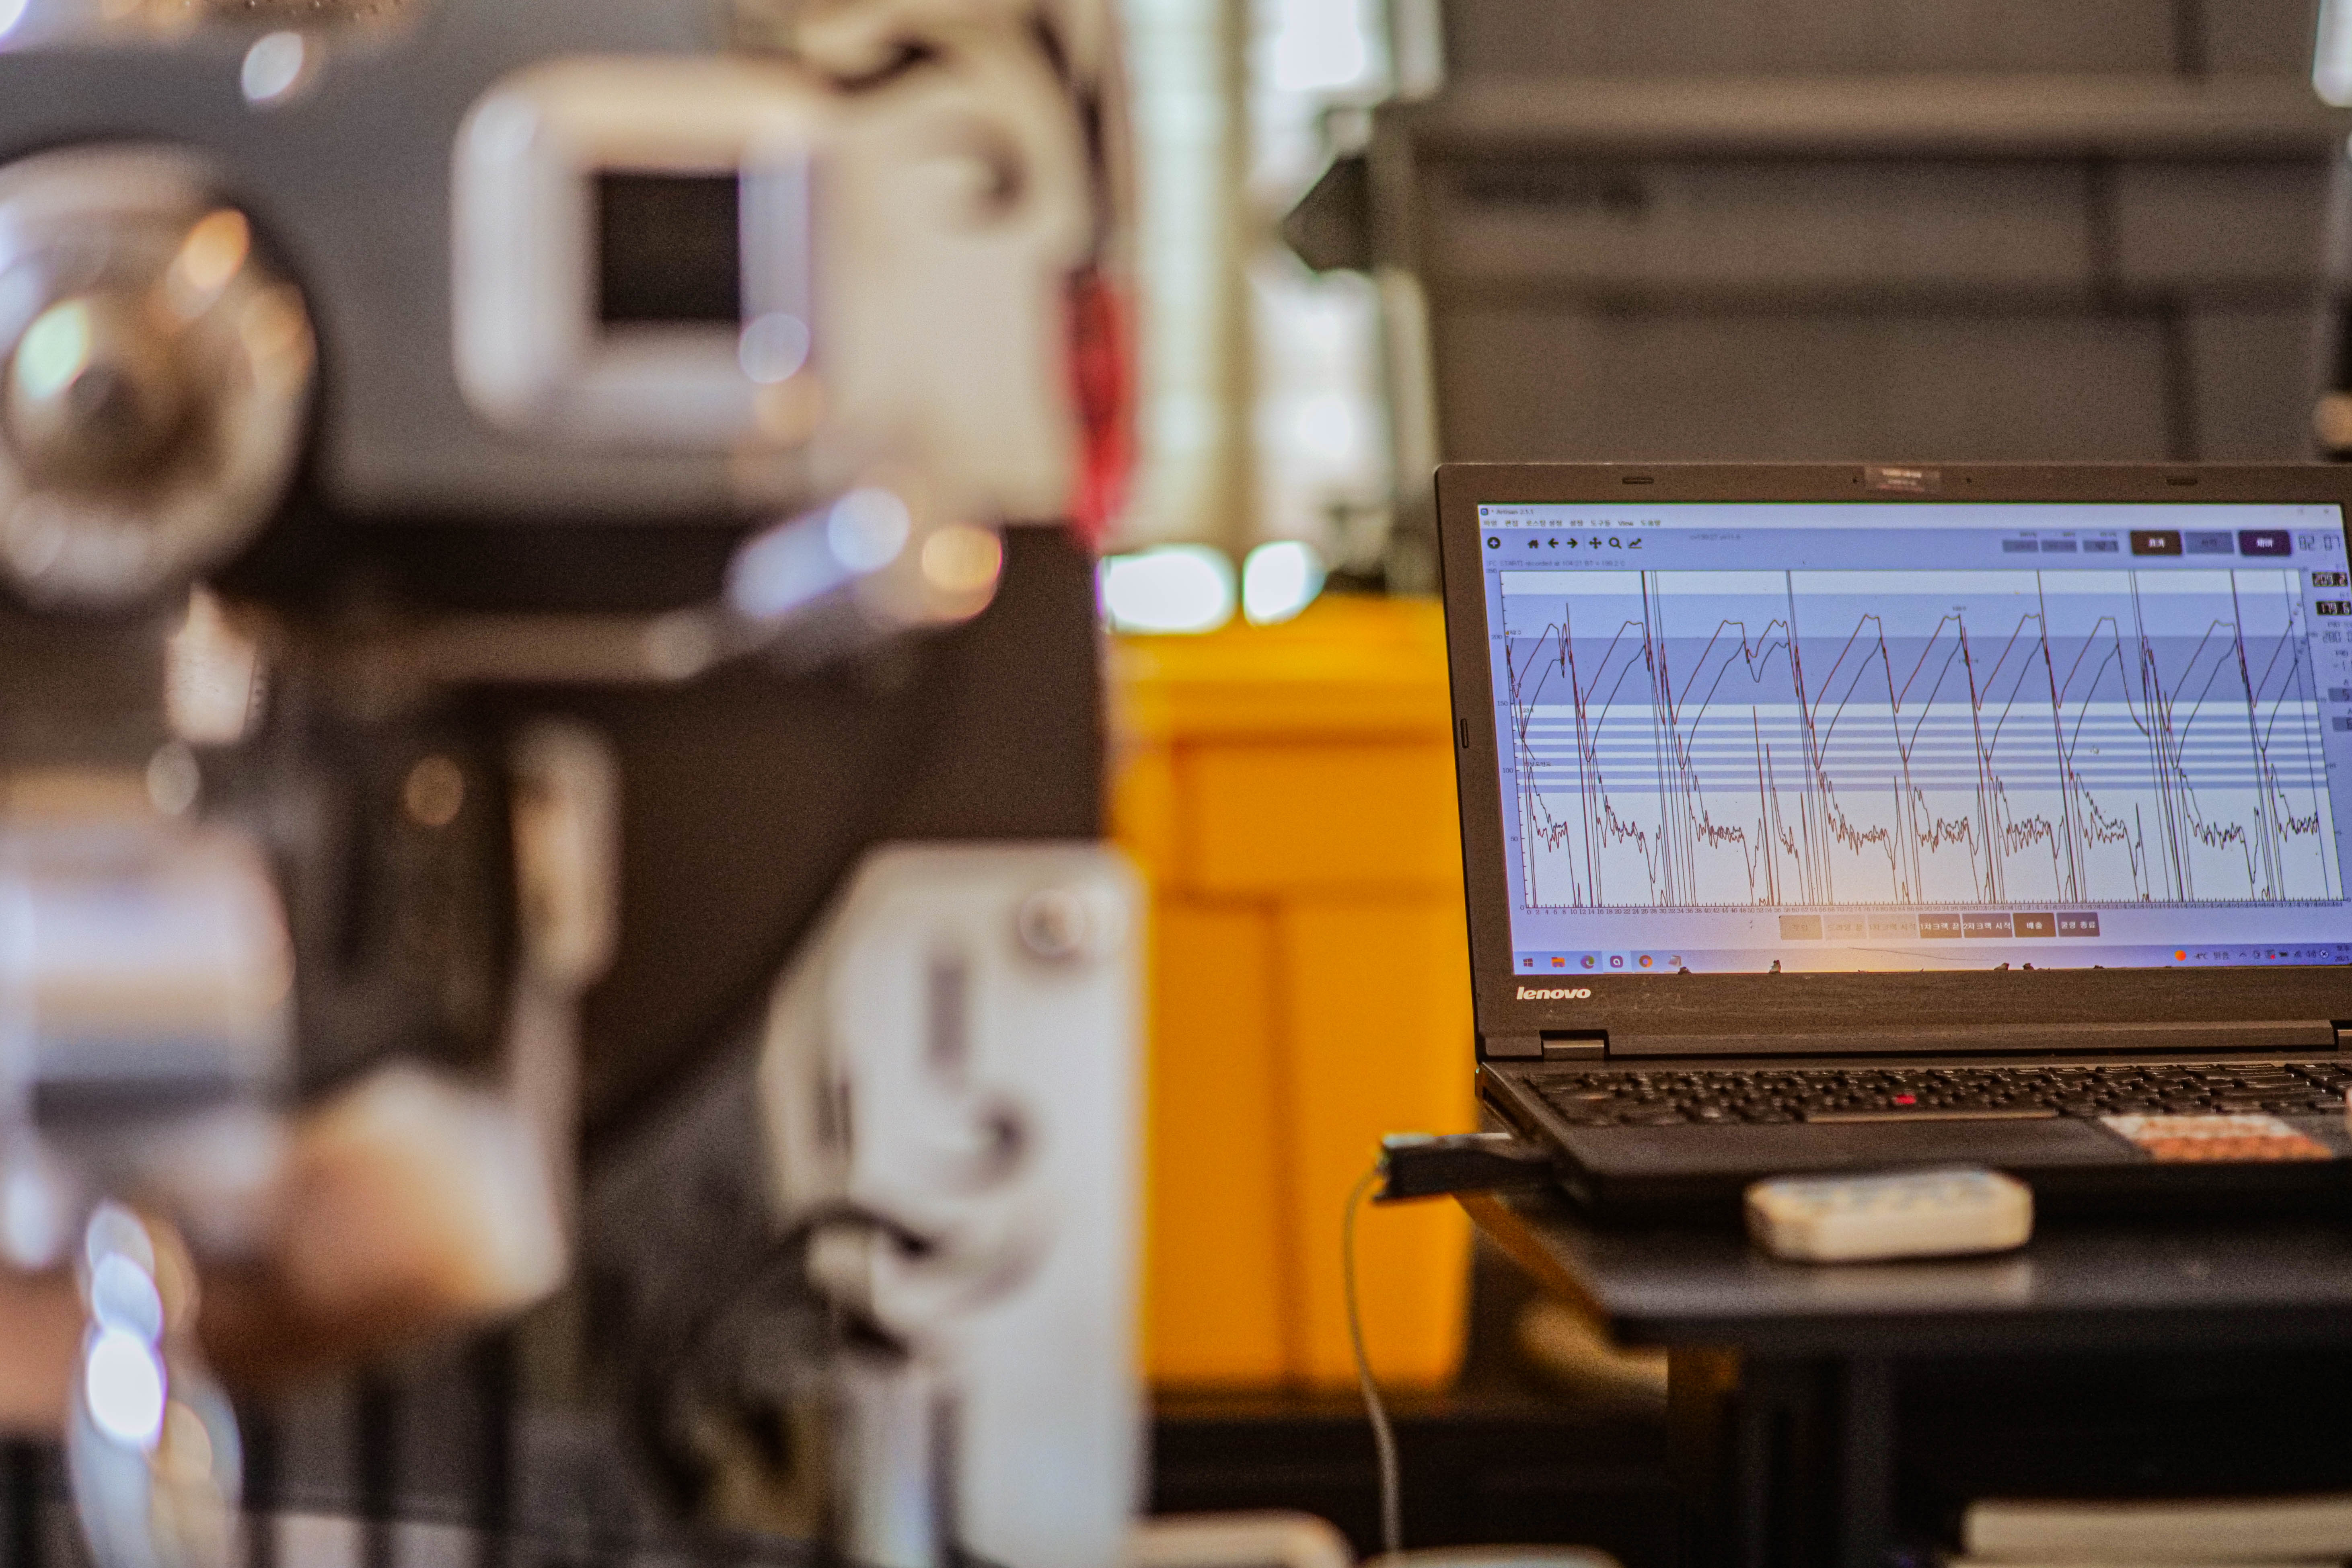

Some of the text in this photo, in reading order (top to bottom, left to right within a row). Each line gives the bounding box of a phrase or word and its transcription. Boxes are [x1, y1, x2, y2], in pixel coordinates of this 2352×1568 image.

[1952, 922, 1959, 930] 끝
[2026, 921, 2042, 929] 배출
[1516, 986, 1591, 1000] lenovo
